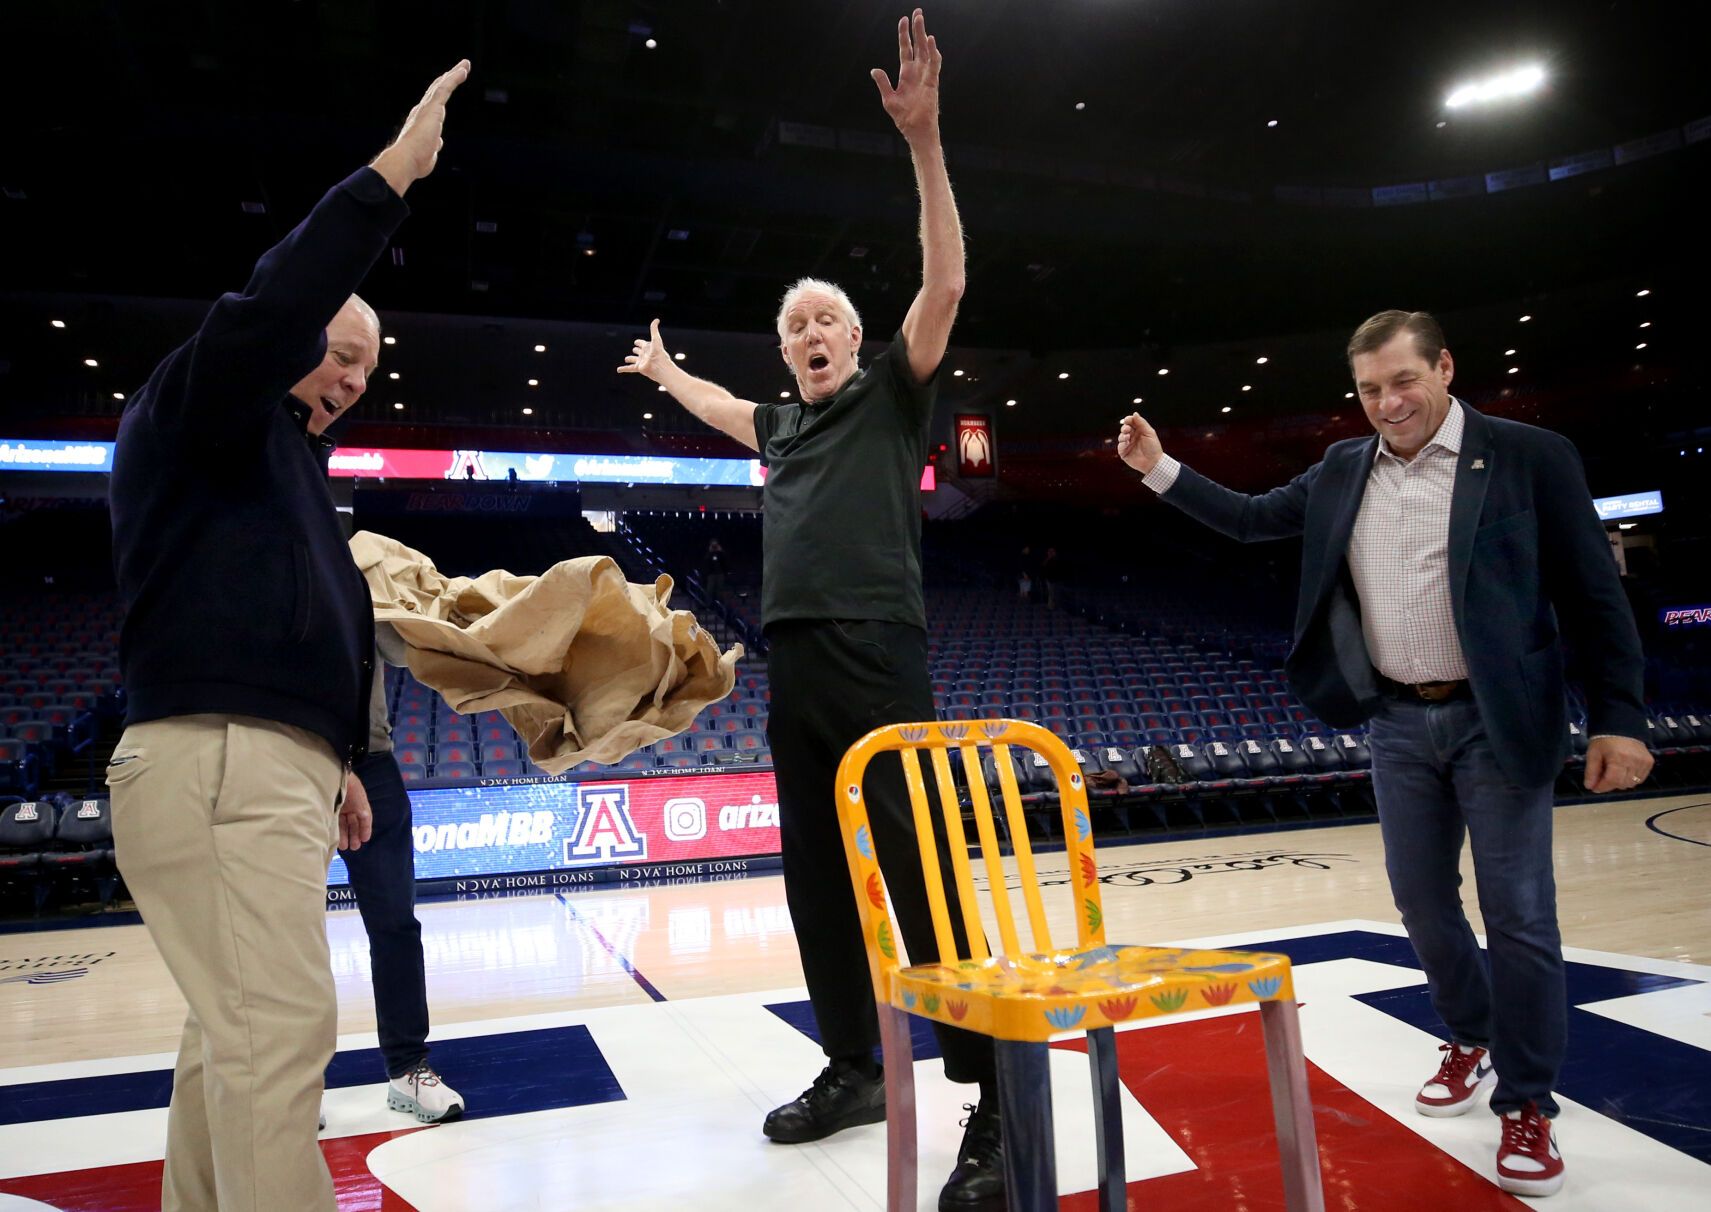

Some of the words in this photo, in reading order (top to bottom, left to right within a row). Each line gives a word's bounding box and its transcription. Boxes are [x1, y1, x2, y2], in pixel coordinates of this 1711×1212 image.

[511, 777, 539, 785] HOME
[563, 784, 648, 865] A
[666, 864, 703, 875] HOME
[709, 861, 748, 873] LOANS
[506, 876, 546, 888] HOME
[553, 872, 595, 884] LOANS
